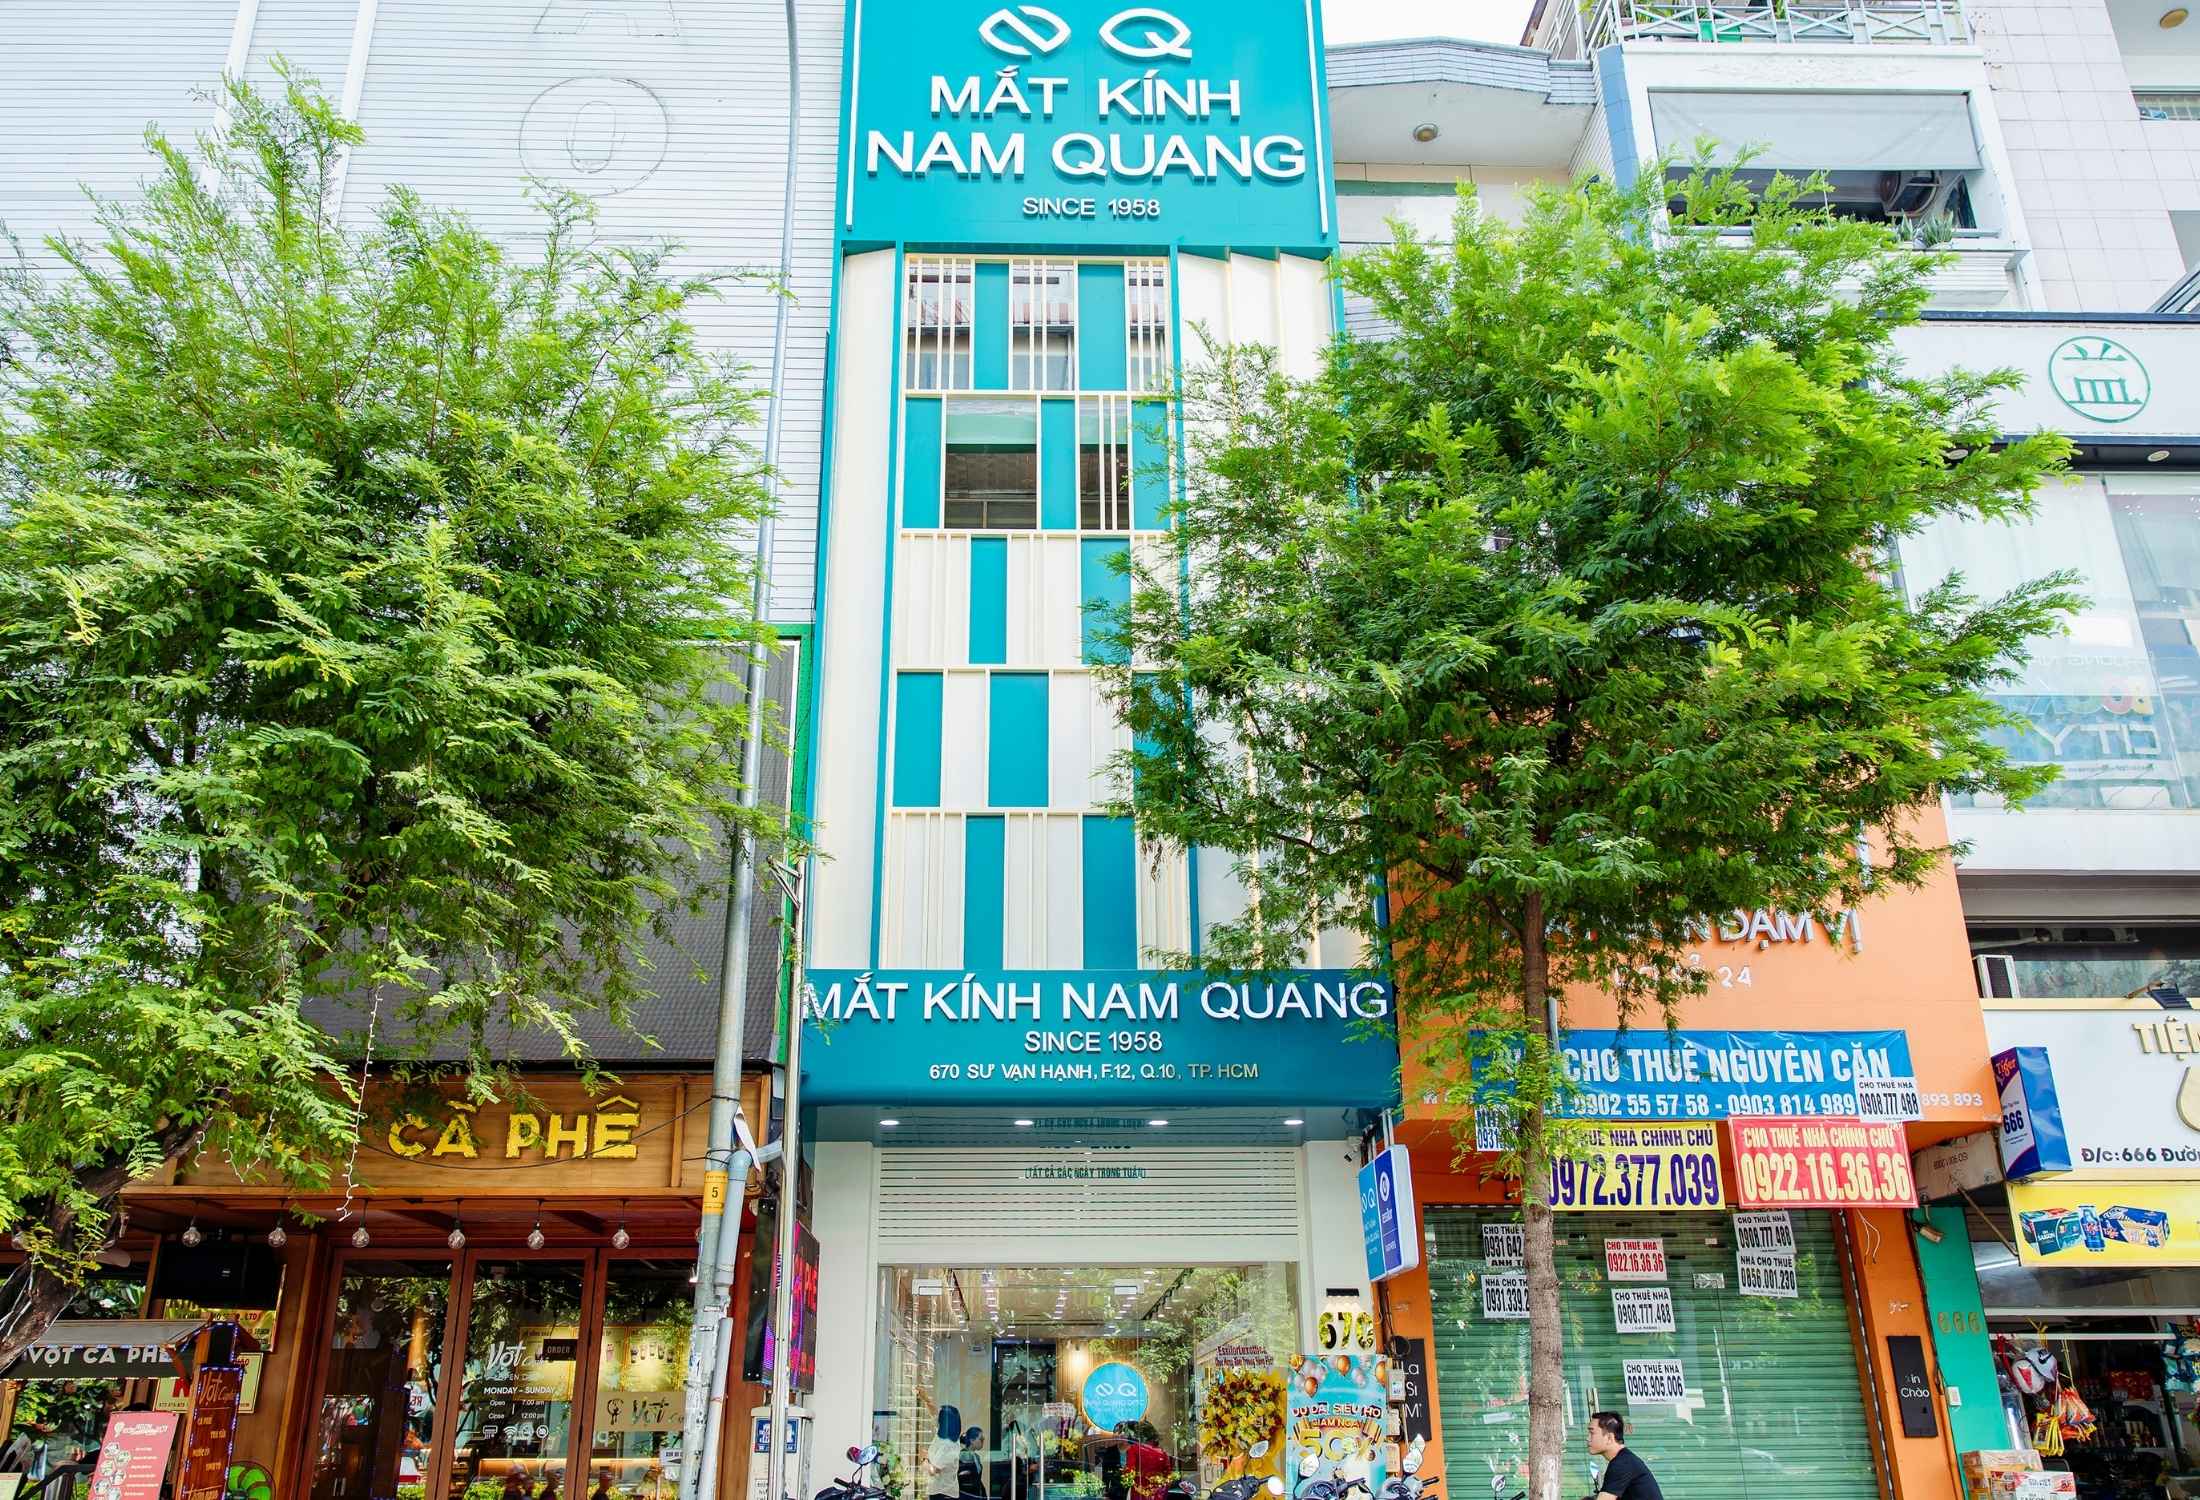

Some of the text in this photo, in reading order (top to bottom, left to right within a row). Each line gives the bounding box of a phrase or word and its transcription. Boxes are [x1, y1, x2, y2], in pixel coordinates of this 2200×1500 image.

[930, 65, 1241, 121] MẮT KÍNH
[866, 130, 1306, 182] NAM QUANG
[1022, 197, 1160, 217] SINCE 1958
[1718, 966, 1751, 988] 24
[800, 971, 1388, 1021] MẮT KÍNH NAM QUANG
[1024, 1031, 1163, 1053] SINCE 1958
[929, 1063, 1259, 1082] 670 SƯ VẠN HẠNH, F.12, Q.10, TP. HCM
[1562, 1048, 1620, 1083] CHO
[1626, 1044, 1700, 1083] THUÊ
[1708, 1043, 1825, 1083] NGUYÊN
[1832, 1042, 1891, 1083] CĂN
[1859, 1081, 1875, 1089] CHO
[1626, 1094, 1651, 1115] 55
[1655, 1094, 1679, 1115] 57
[1685, 1094, 1709, 1115] 58
[1728, 1094, 1775, 1115] 0903
[1780, 1093, 1815, 1115] 814
[1820, 1092, 1856, 1115] 989
[388, 1095, 641, 1159] CÀ PHÊ
[2003, 1110, 2025, 1134] 666
[1641, 1126, 1684, 1147] CHÍNH
[1687, 1123, 1714, 1147] CHỦ
[1743, 1127, 1769, 1148] CHO
[1770, 1124, 1801, 1148] THUÊ
[1802, 1123, 1830, 1148] NHÀ
[1830, 1125, 1868, 1148] CHÍNH
[2161, 1145, 2200, 1162] Đườ
[1550, 1153, 1720, 1206] 0972.377.039
[1741, 1152, 1912, 1201] 0922.16.36.36
[711, 1186, 719, 1198] 5
[1737, 1216, 1752, 1224] CHO
[1606, 1241, 1621, 1250] CHO
[1738, 1225, 1792, 1249] 0908.777.488
[1757, 1256, 1772, 1266] CHO
[1614, 1292, 1631, 1301] CHO
[1617, 1303, 1672, 1325] 0908.777.488
[1318, 1311, 1375, 1350] 670
[547, 1345, 571, 1354] ORDER
[1626, 1364, 1642, 1373] CHO
[525, 1386, 555, 1394] SUNDAY
[1627, 1375, 1684, 1397] 0906.905.006
[1900, 1387, 1930, 1398] Chào
